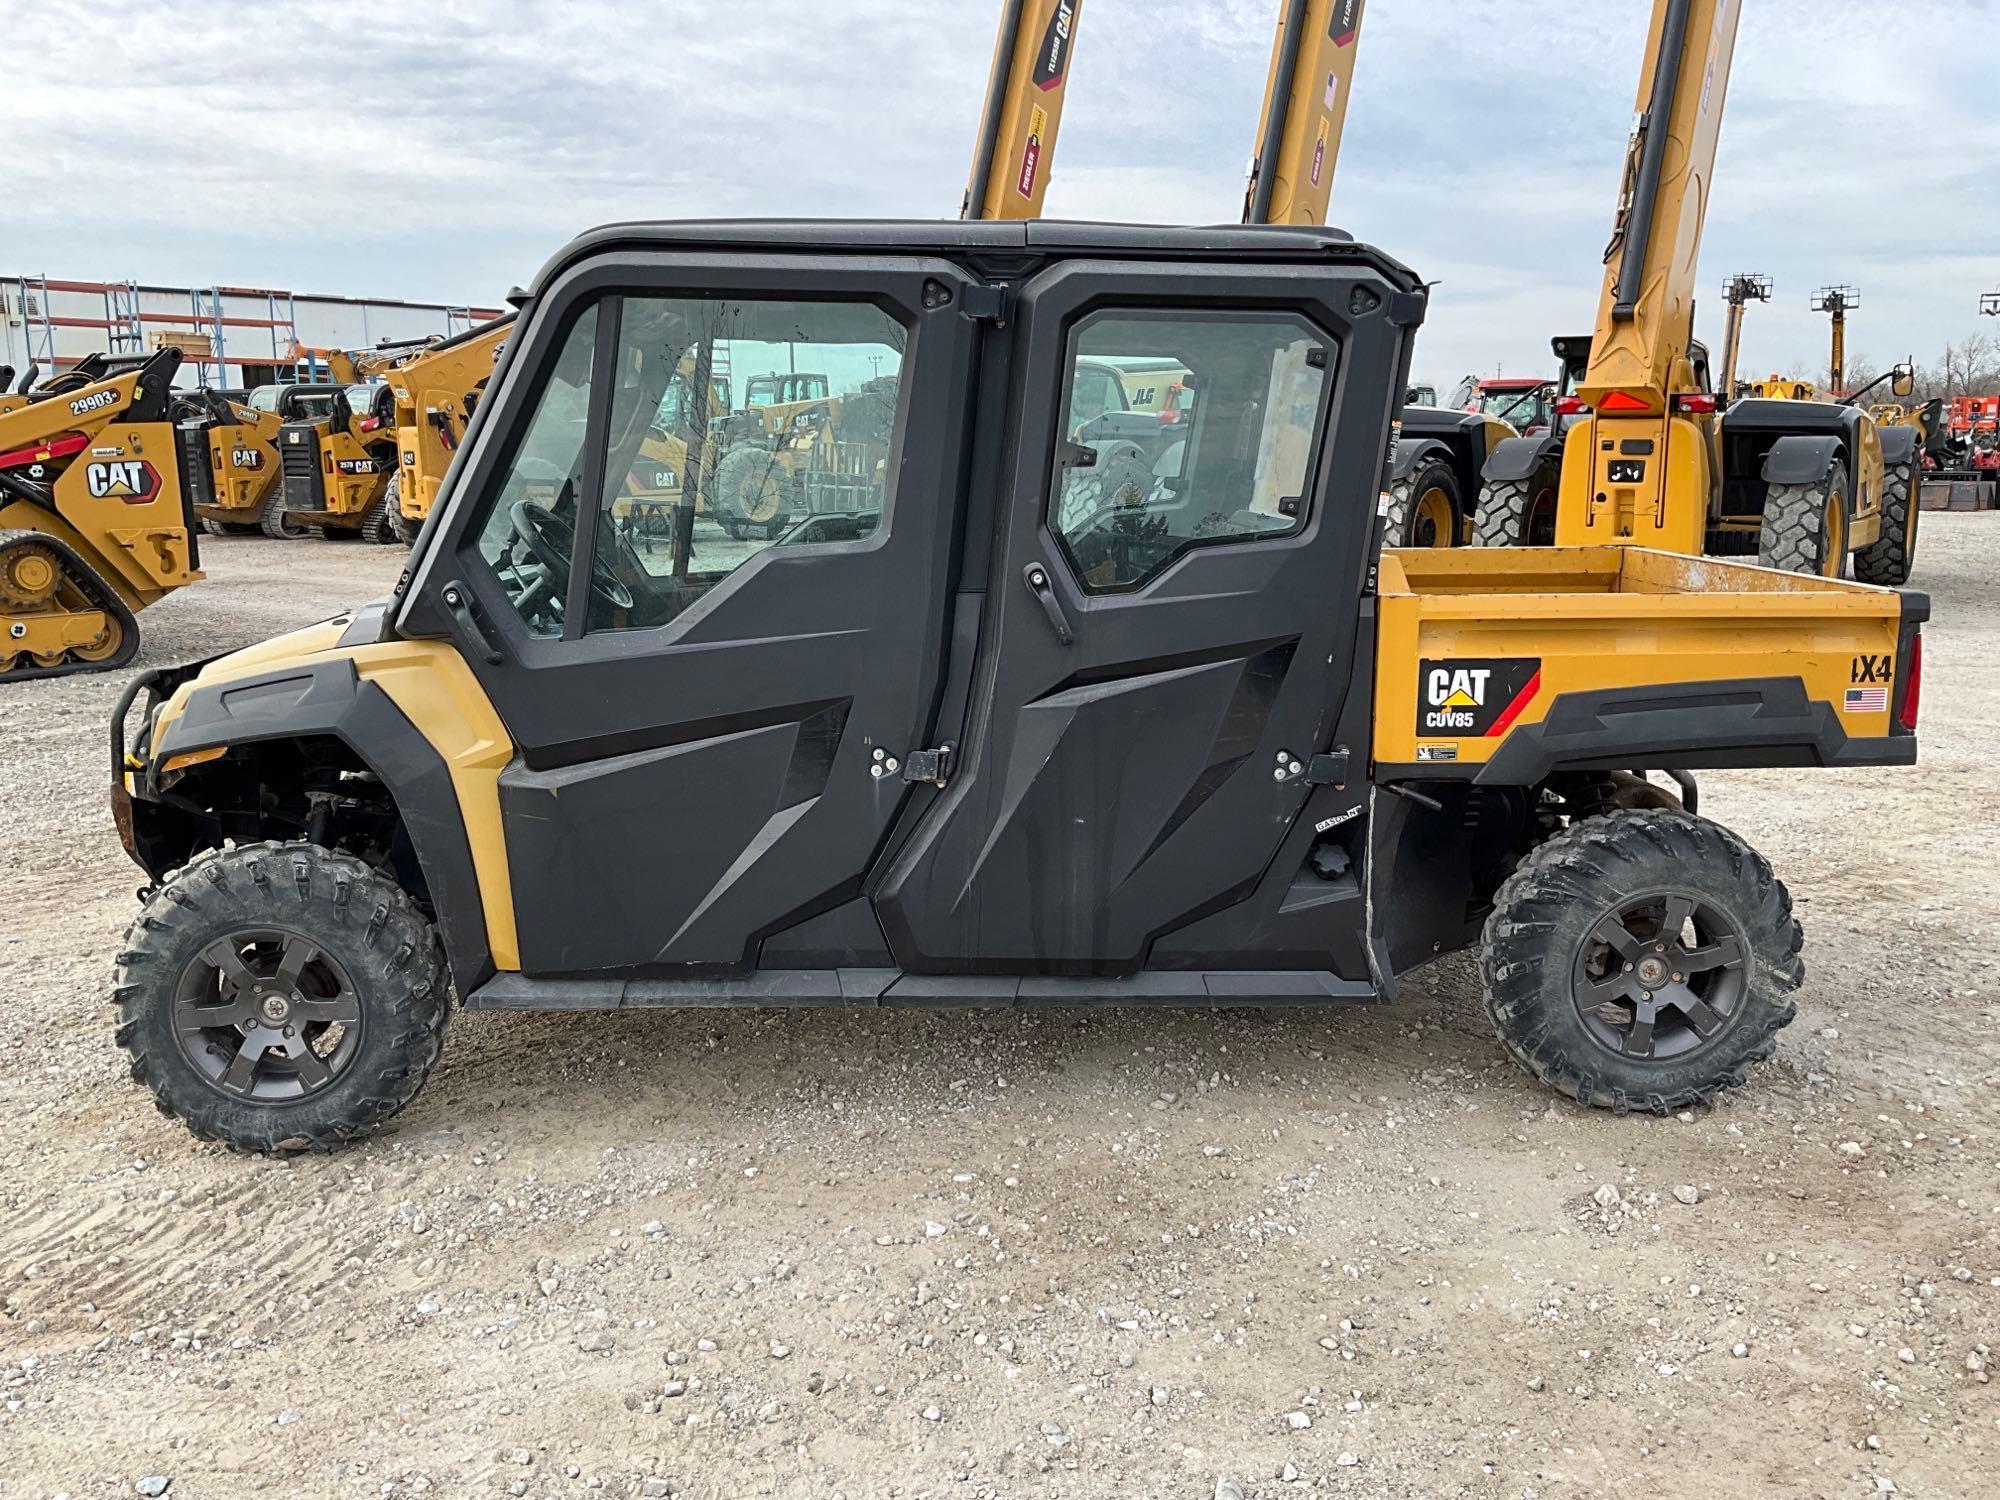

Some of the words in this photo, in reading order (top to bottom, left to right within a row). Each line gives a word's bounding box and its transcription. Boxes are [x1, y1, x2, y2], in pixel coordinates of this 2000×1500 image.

[1048, 36, 1061, 74] TL12550
[1056, 0, 1073, 40] CAT
[1022, 152, 1035, 191] ZIEGLER
[70, 390, 113, 416] 299D3
[1132, 387, 1155, 406] JLG
[232, 449, 258, 467] CAT
[356, 460, 373, 473] CAT
[87, 462, 143, 497] CAT
[655, 472, 675, 487] CAT
[1428, 669, 1491, 706] CAT
[1426, 712, 1474, 728] CUV85
